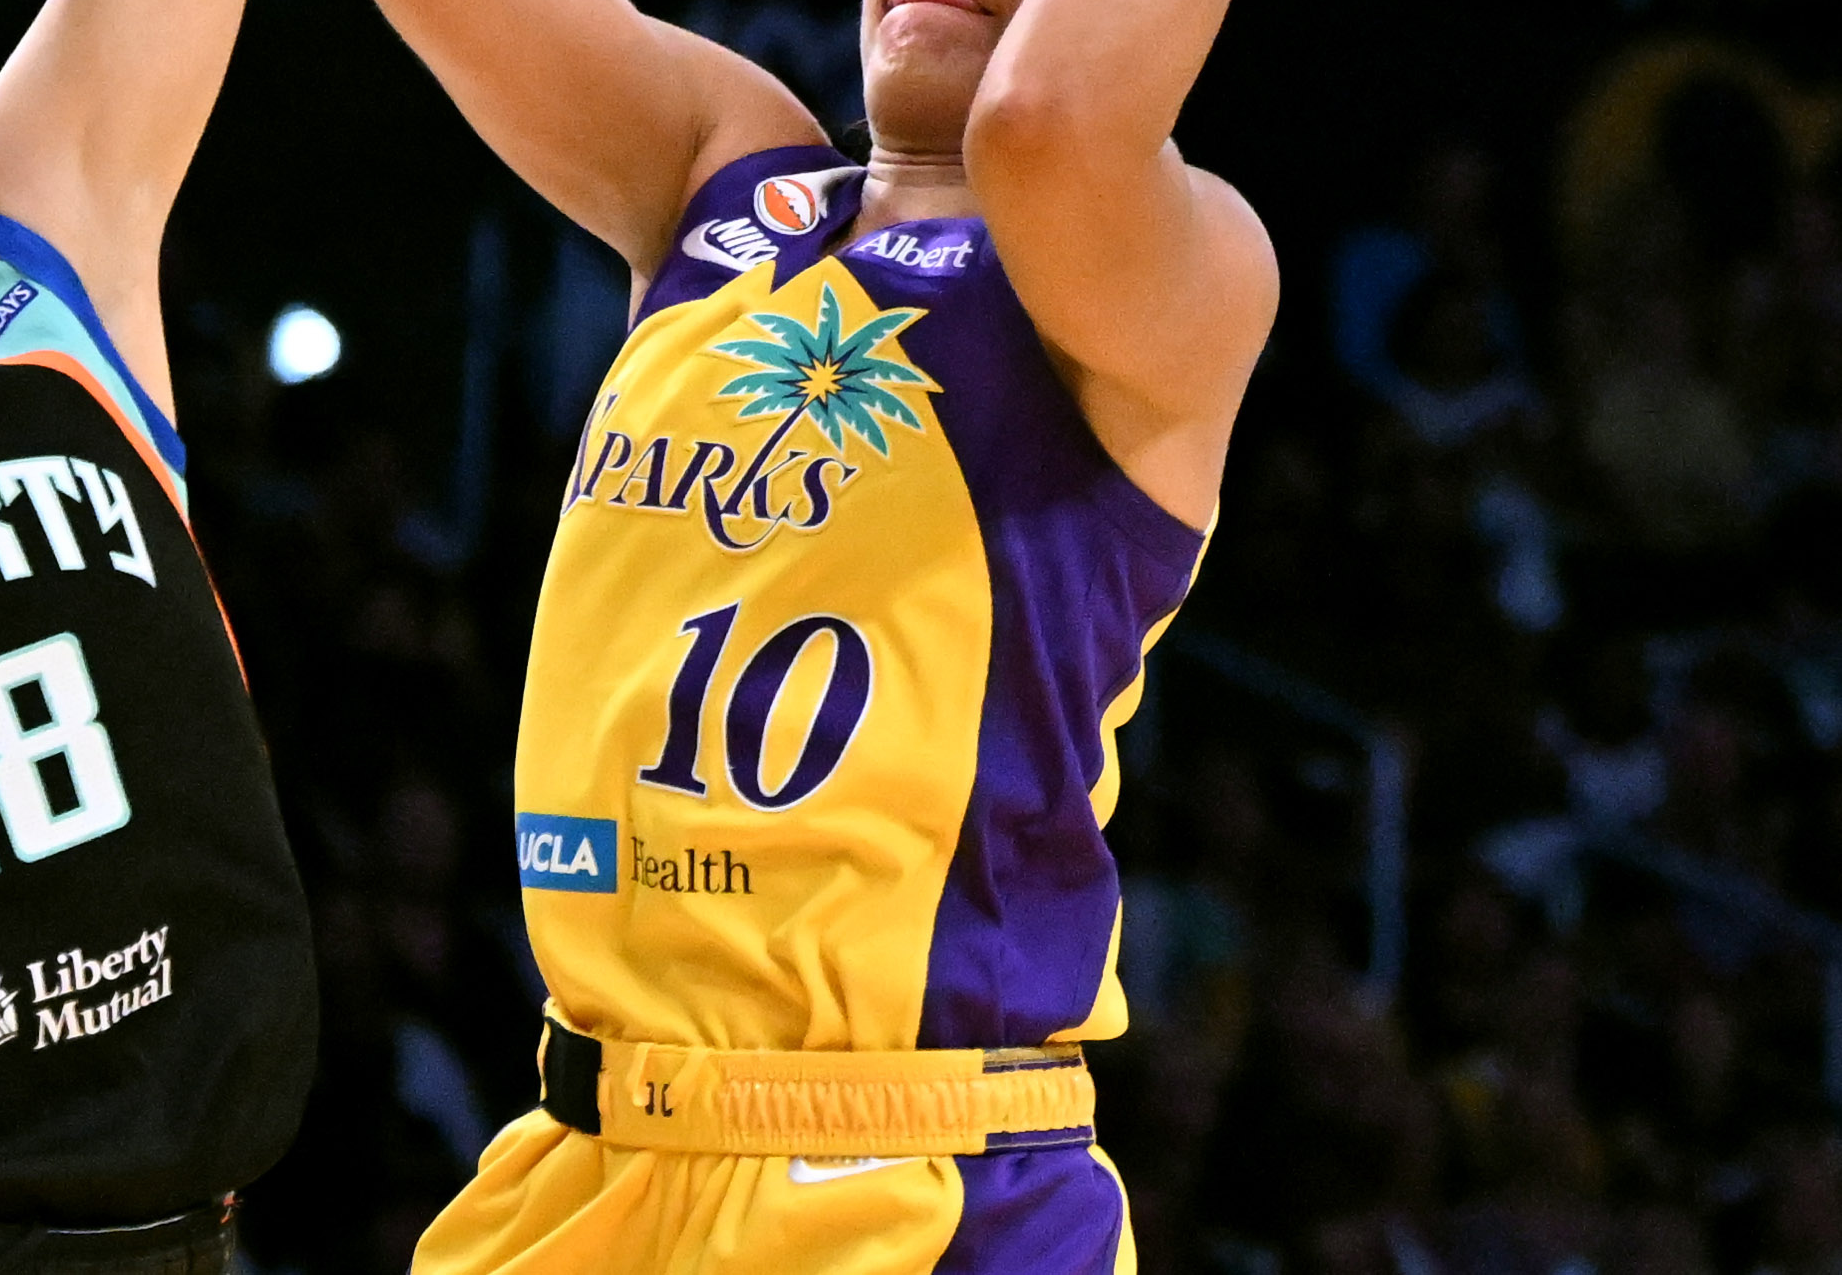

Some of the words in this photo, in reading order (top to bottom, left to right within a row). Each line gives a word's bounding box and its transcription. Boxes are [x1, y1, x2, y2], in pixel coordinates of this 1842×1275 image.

[857, 230, 973, 269] Albert
[636, 599, 874, 813] 10
[518, 831, 598, 877] UCLA
[631, 836, 755, 895] Health
[26, 925, 169, 1003] Liberty
[33, 958, 173, 1051] Mutual
